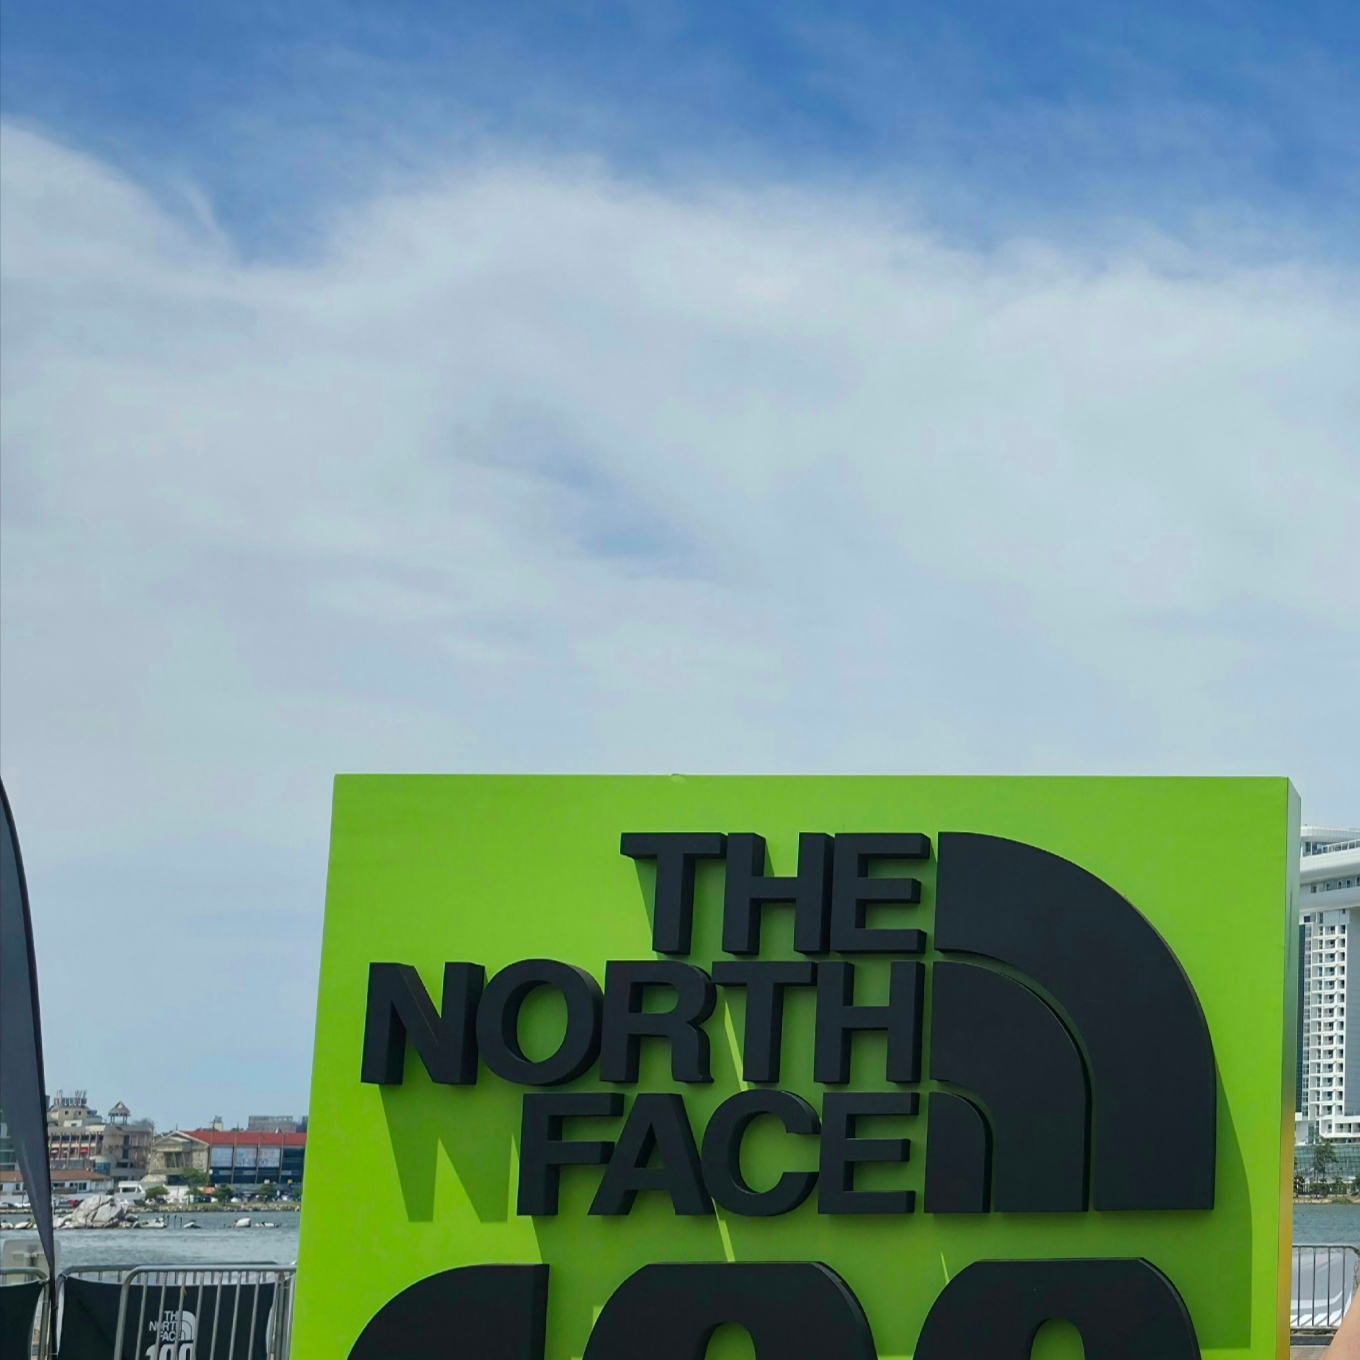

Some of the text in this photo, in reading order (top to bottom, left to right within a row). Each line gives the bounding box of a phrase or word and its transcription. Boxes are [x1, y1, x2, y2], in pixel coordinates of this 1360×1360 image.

[620, 832, 931, 955] THE
[361, 958, 926, 1086] NORTH
[517, 1089, 922, 1217] FACE
